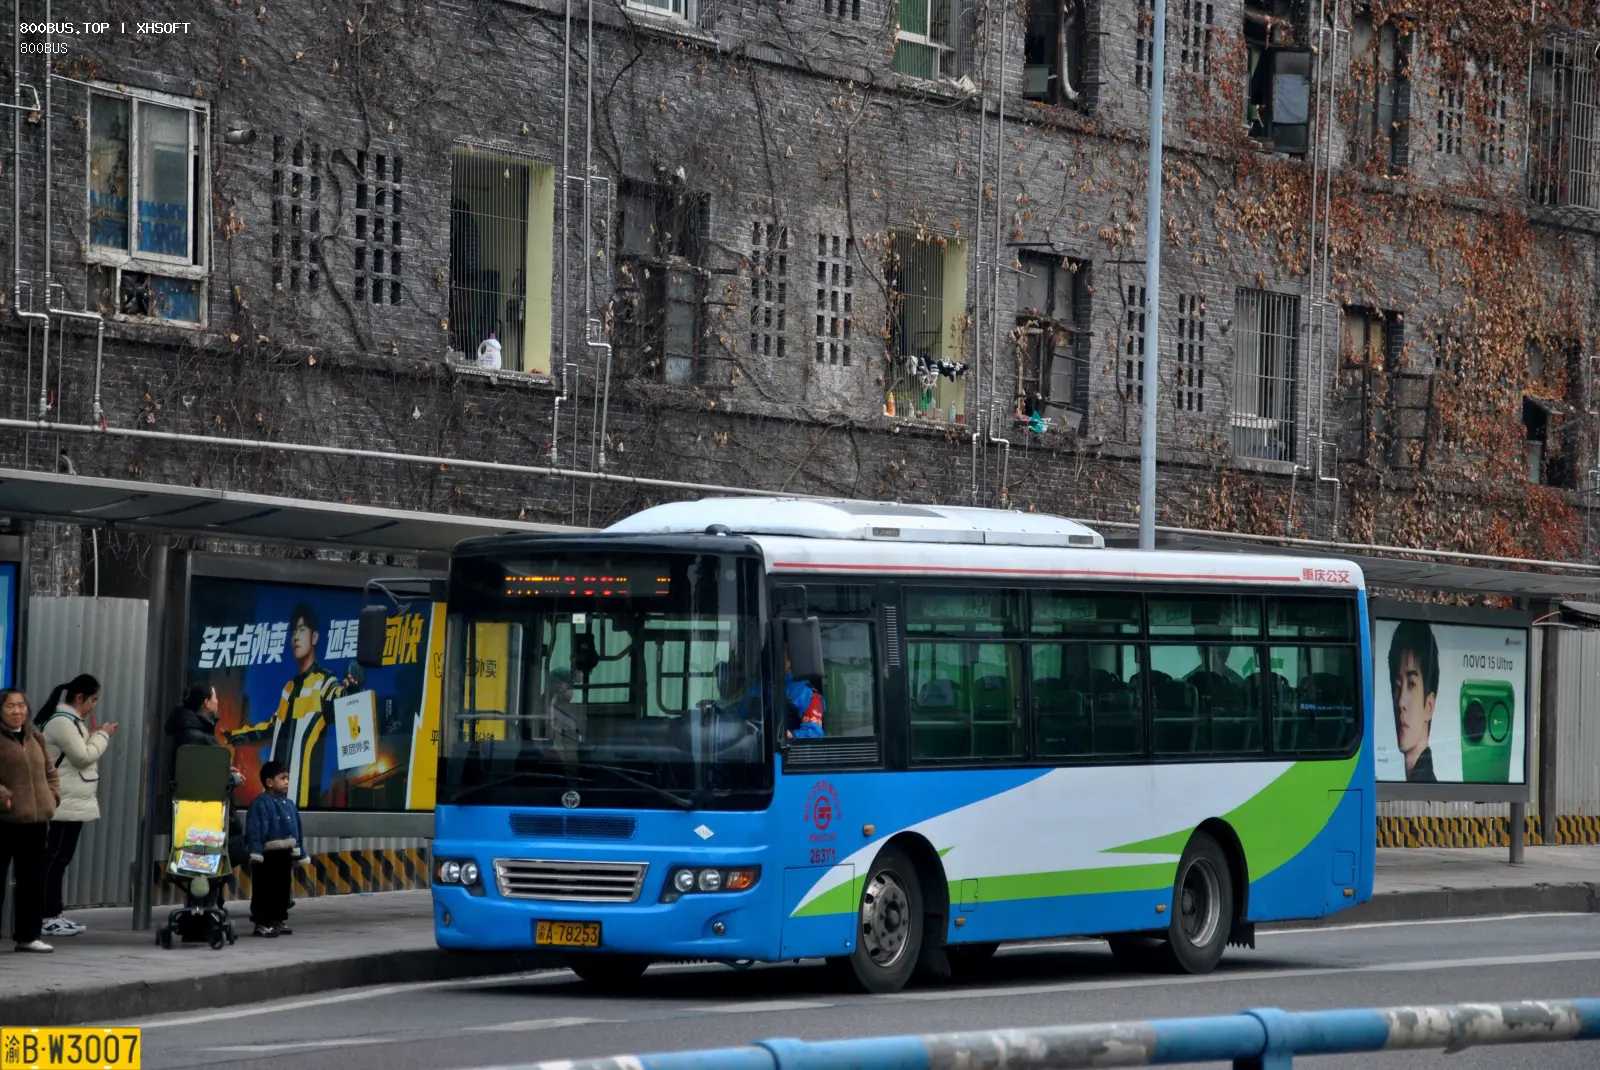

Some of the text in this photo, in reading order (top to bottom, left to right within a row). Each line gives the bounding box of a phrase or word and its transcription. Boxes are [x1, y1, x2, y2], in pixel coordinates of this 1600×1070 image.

[1302, 567, 1350, 583] 重庆公交
[198, 621, 290, 669] 冬天点外卖
[1463, 654, 1513, 671] nova 15 Ultra
[810, 848, 836, 864] 26371
